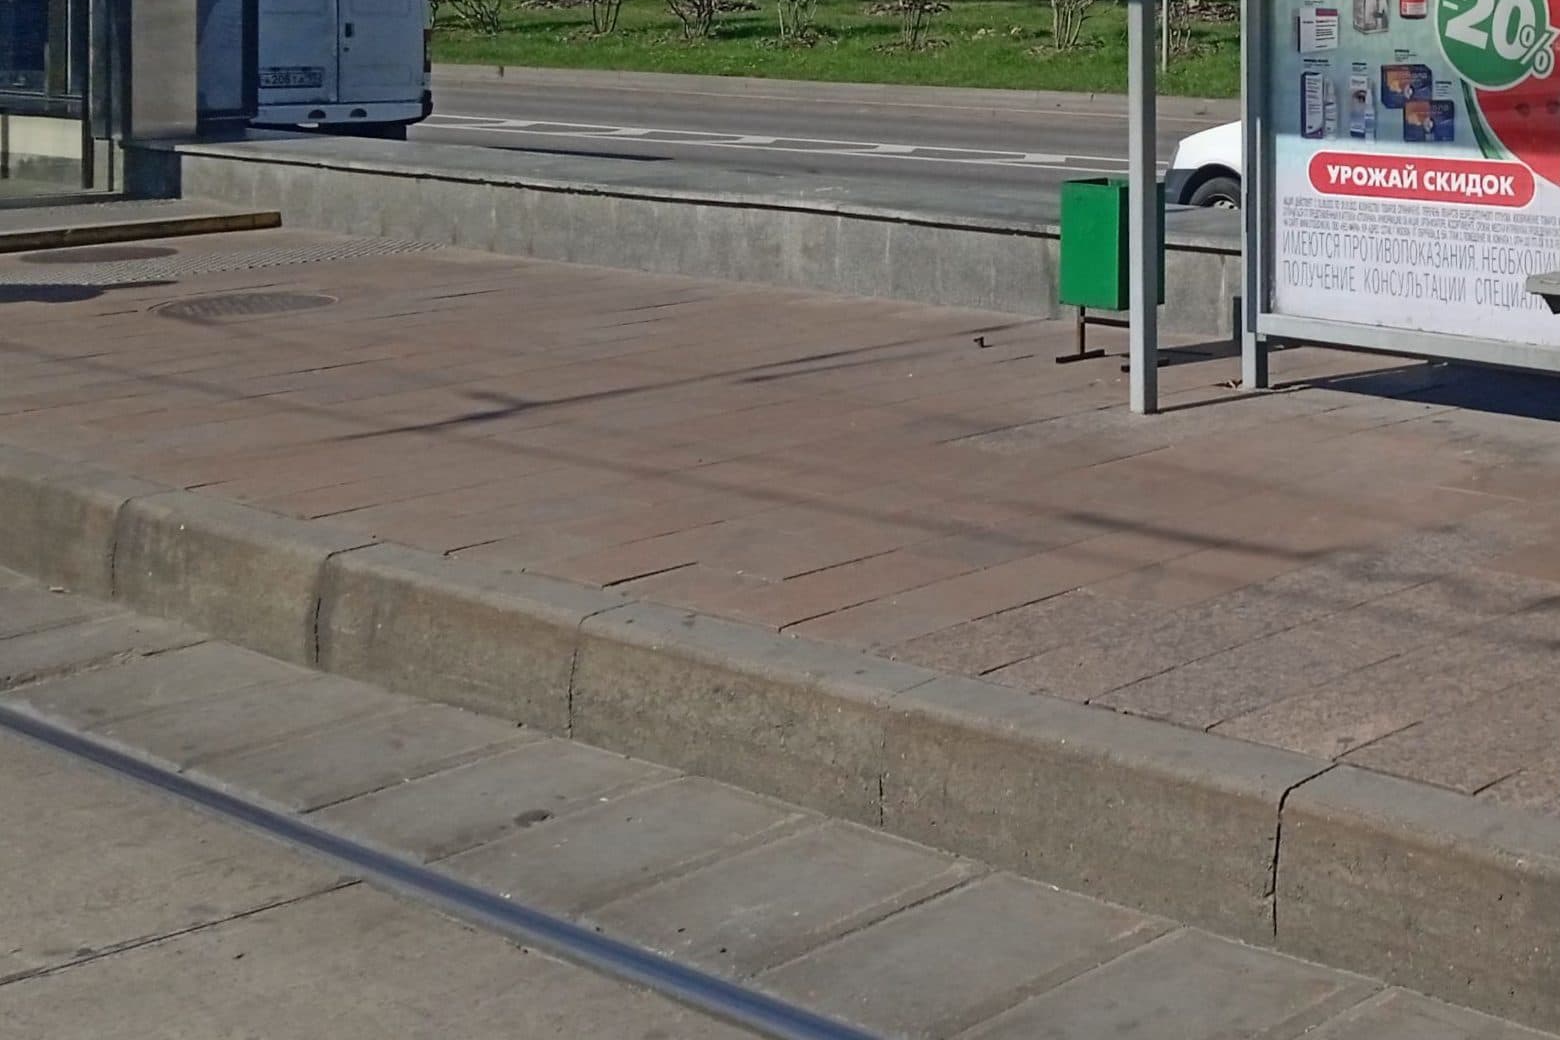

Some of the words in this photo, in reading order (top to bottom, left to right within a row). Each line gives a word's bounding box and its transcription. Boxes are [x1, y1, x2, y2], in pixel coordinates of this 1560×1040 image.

[1326, 163, 1418, 190] УРОЖАЙ
[1423, 170, 1515, 197] СКИДОК
[1283, 229, 1340, 258] ИМЕЮТСЯ
[1283, 259, 1356, 293] ПОЛУЧЕНИЕ
[1363, 267, 1466, 304] КОНСУЛЬТАЦИИ
[1475, 277, 1547, 311] СПЕЦИАЛ
